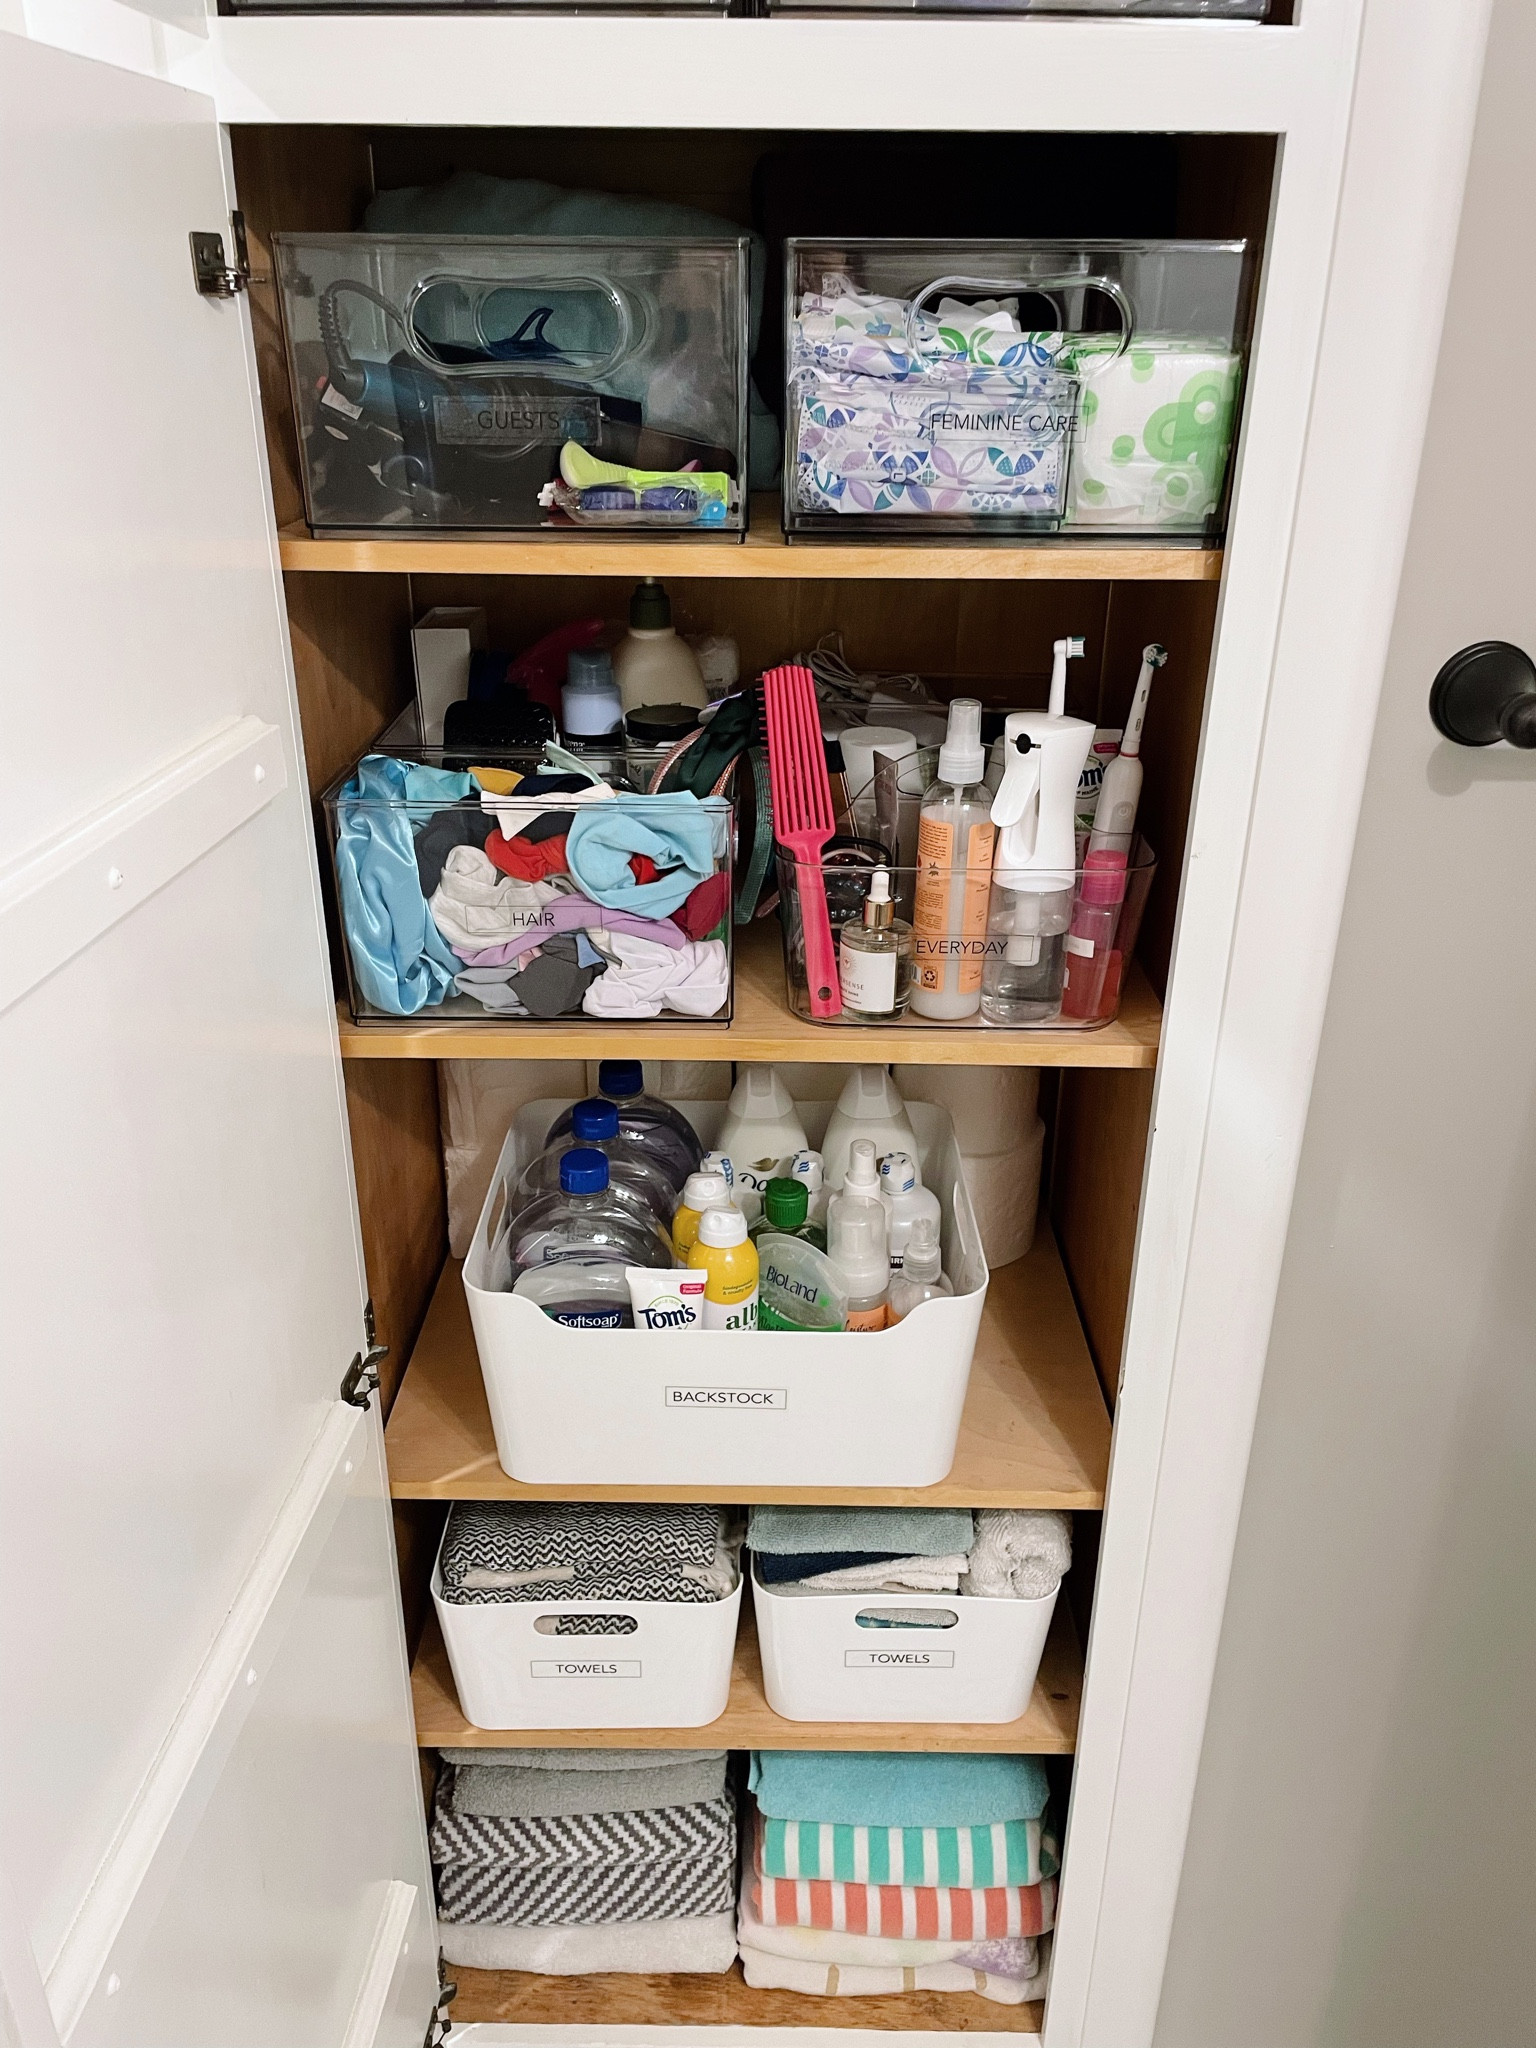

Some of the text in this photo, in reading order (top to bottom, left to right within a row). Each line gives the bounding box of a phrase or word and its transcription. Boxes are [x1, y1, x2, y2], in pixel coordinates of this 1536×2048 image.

[477, 410, 560, 430] GUESTS
[931, 413, 1078, 432] FEMININE CARE
[512, 912, 555, 927] HAIR
[916, 940, 1009, 955] EVERYDAY
[558, 1313, 619, 1328] Softsoap
[638, 1303, 697, 1330] Tom's
[673, 1391, 774, 1404] BACKSTOCK
[868, 1653, 931, 1664] TOWELS
[556, 1664, 617, 1674] TOWELS
